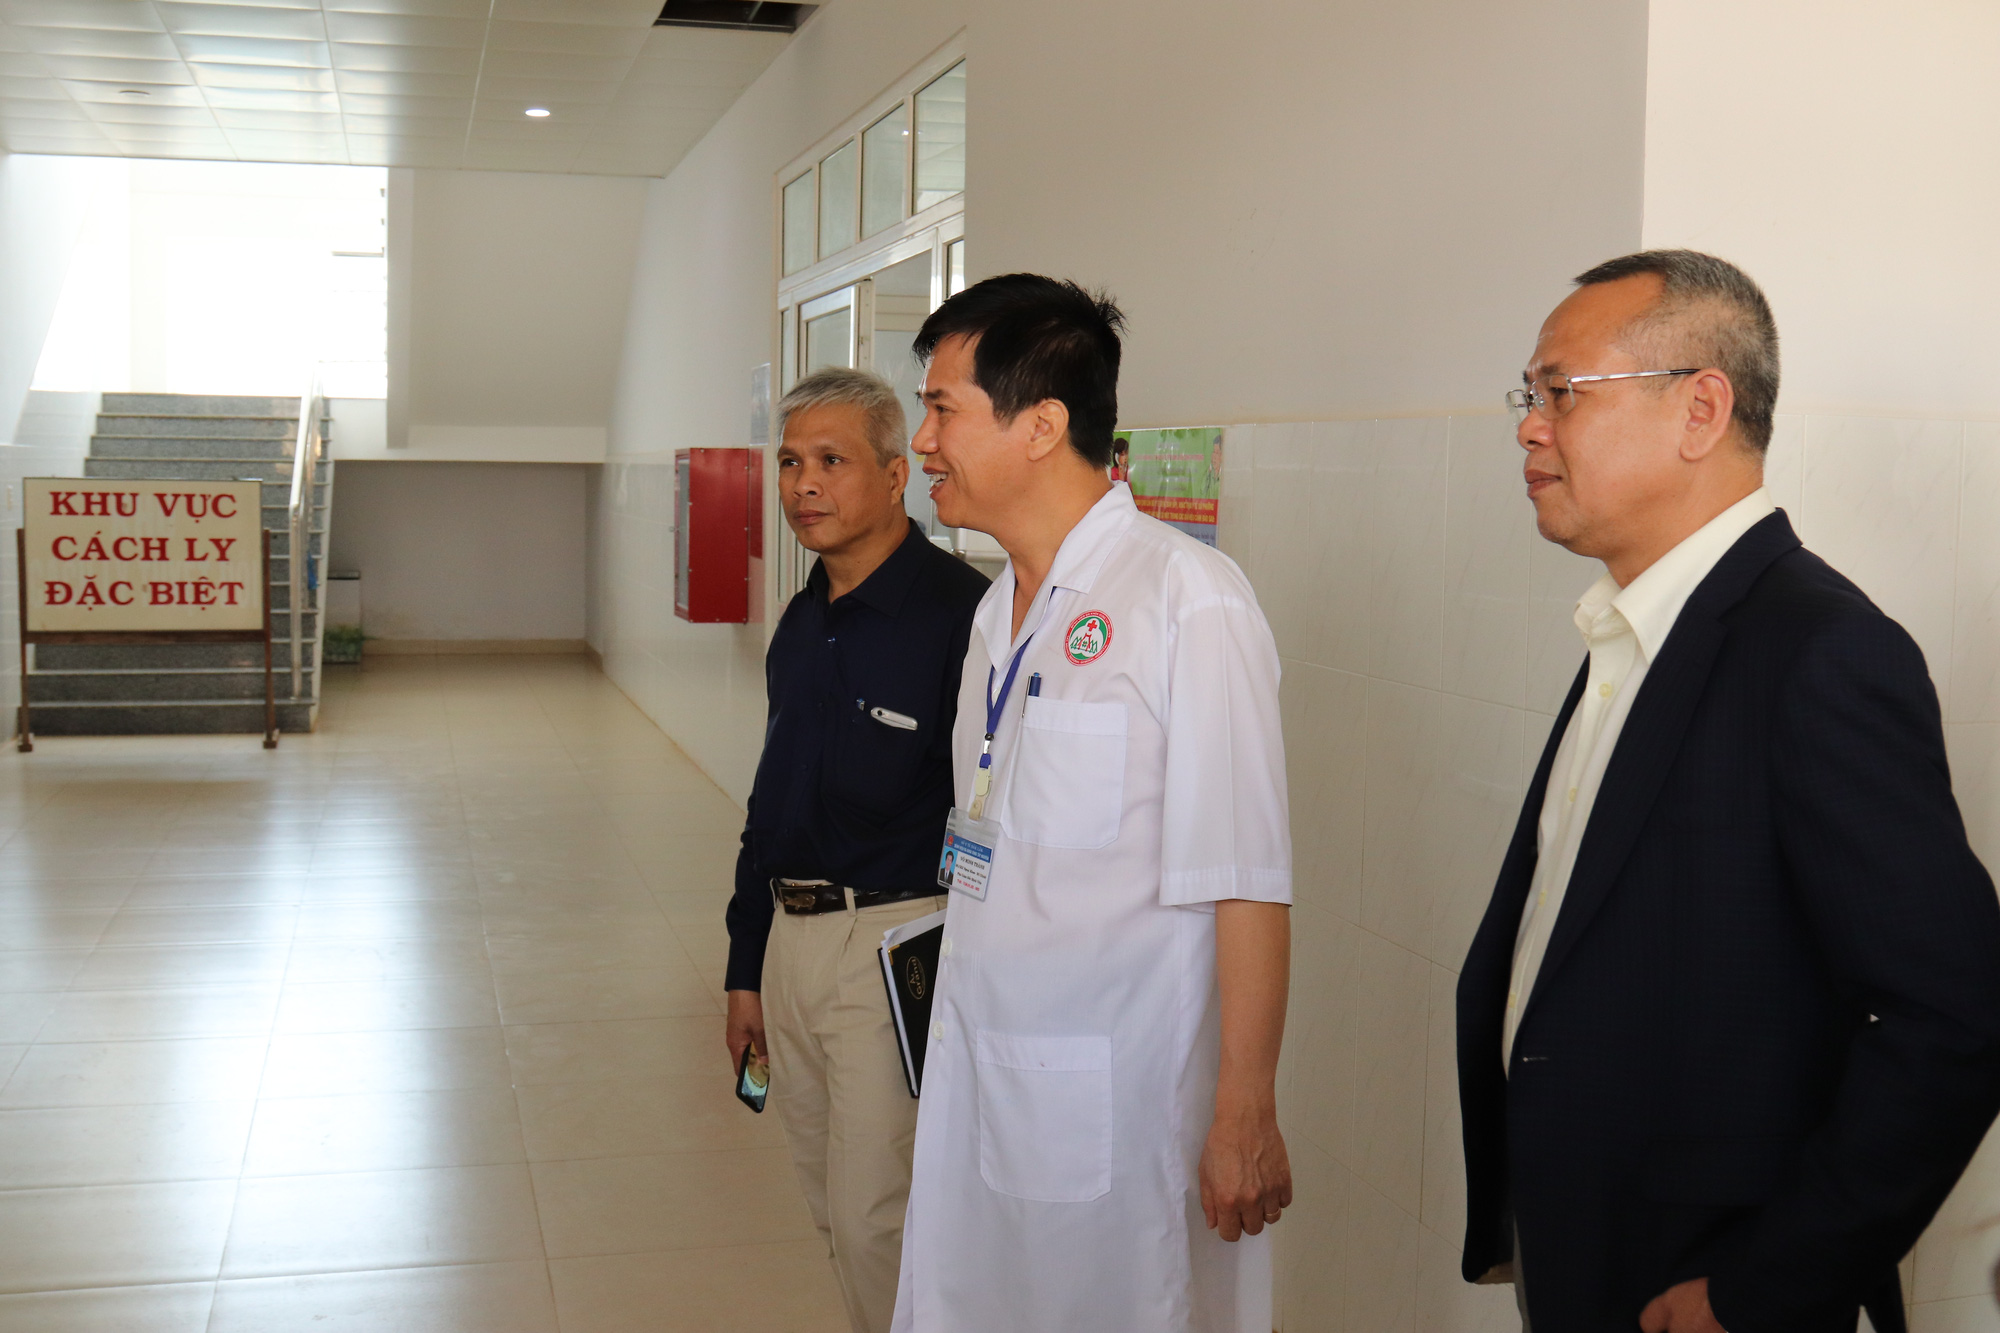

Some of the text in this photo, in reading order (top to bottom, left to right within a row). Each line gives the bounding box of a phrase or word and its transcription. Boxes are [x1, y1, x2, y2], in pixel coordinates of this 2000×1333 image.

[49, 490, 238, 524] KHU VỰC
[51, 530, 237, 562] CÁCH LY
[44, 575, 245, 611] ĐẶC BIỆT
